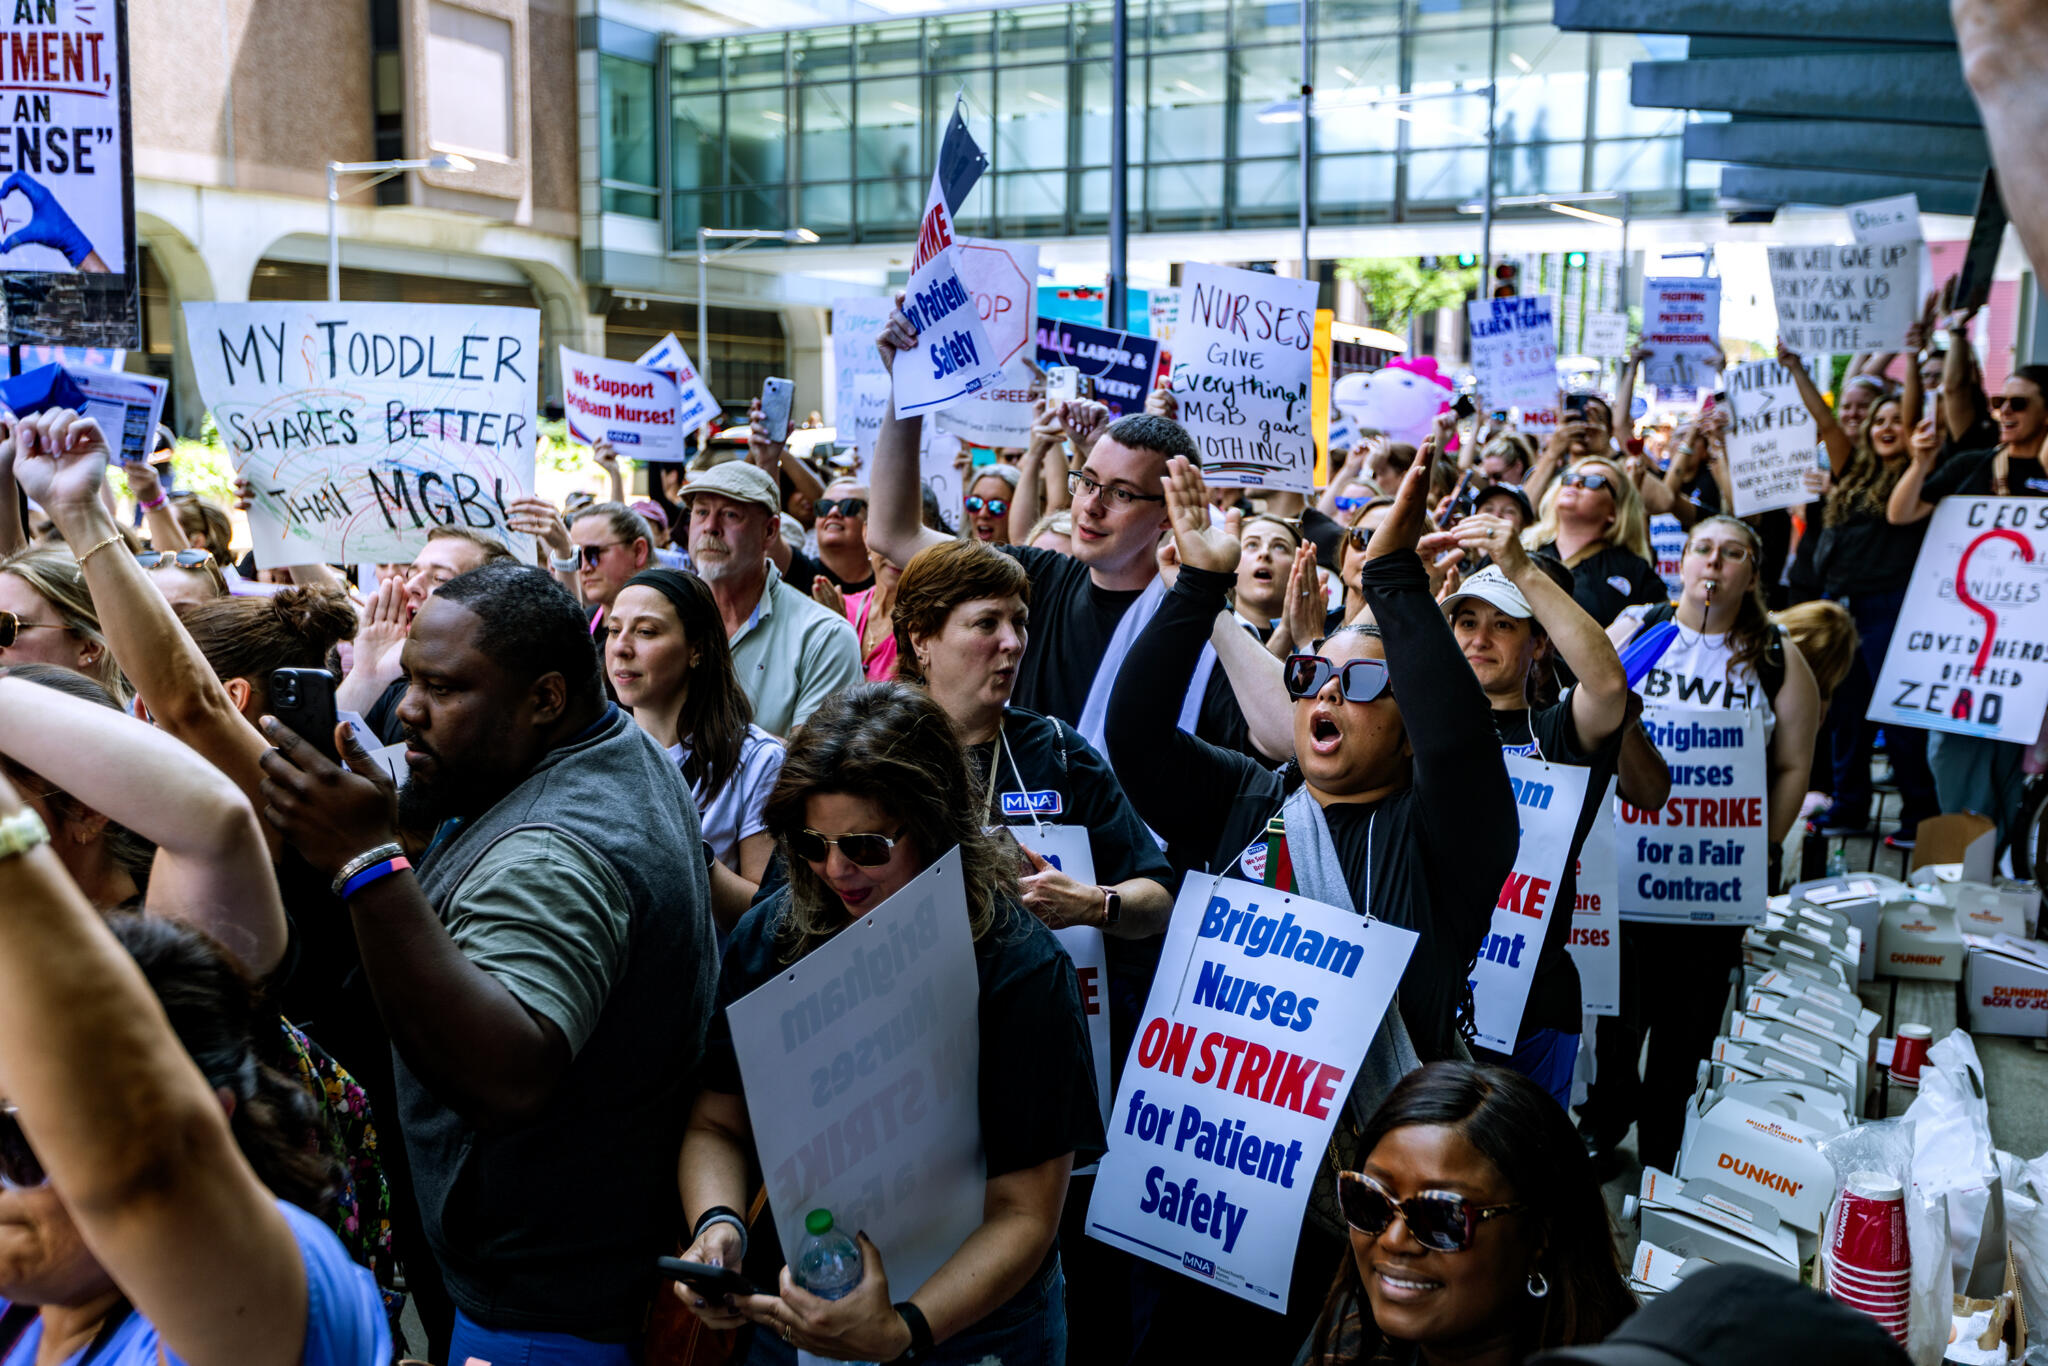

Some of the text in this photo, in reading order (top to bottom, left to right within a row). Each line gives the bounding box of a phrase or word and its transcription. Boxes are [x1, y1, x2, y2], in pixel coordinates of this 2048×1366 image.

[13, 0, 57, 25] AN
[13, 95, 50, 122] AN
[912, 202, 952, 276] TRIKE
[1839, 247, 1873, 269] GIVE
[1881, 246, 1907, 268] UP
[1821, 277, 1856, 299] ASK
[1864, 275, 1890, 299] US
[1192, 283, 1311, 350] NURSES
[1802, 302, 1840, 322] LONG
[1846, 302, 1876, 323] WE
[218, 320, 527, 386] MY TODDLER
[1036, 328, 1075, 355] ALL
[1077, 341, 1131, 367] LABOR
[1131, 352, 1148, 370] &
[1808, 327, 1826, 347] TO
[1831, 327, 1862, 349] PEE
[930, 329, 980, 380] Safety
[1207, 342, 1264, 369] GIVE
[1503, 345, 1557, 367] STOP
[572, 368, 590, 389] We
[593, 374, 655, 400] Support
[229, 400, 527, 451] SHARES BETTER
[614, 402, 676, 426] Nurses!
[1184, 401, 1246, 426] MGB
[1258, 419, 1306, 443] gave
[267, 481, 353, 524] THAN
[1908, 631, 1980, 654] COVID
[1643, 668, 1754, 710] BWH
[1668, 764, 1734, 786] urses
[1005, 794, 1054, 810] MNA
[1666, 797, 1762, 827] STRIKE
[1637, 837, 1745, 865] for a Fair
[1638, 873, 1742, 902] Contract
[1197, 895, 1364, 979] Brigham
[1192, 960, 1320, 1033] Nurses
[1982, 996, 2012, 1009] BOX
[1137, 1016, 1347, 1122] ON STRIKE
[1123, 1089, 1304, 1190] for Patient
[1717, 1152, 1803, 1197] DUNKIN'
[1139, 1165, 1249, 1254] Safety
[1184, 1253, 1212, 1274] MNA
